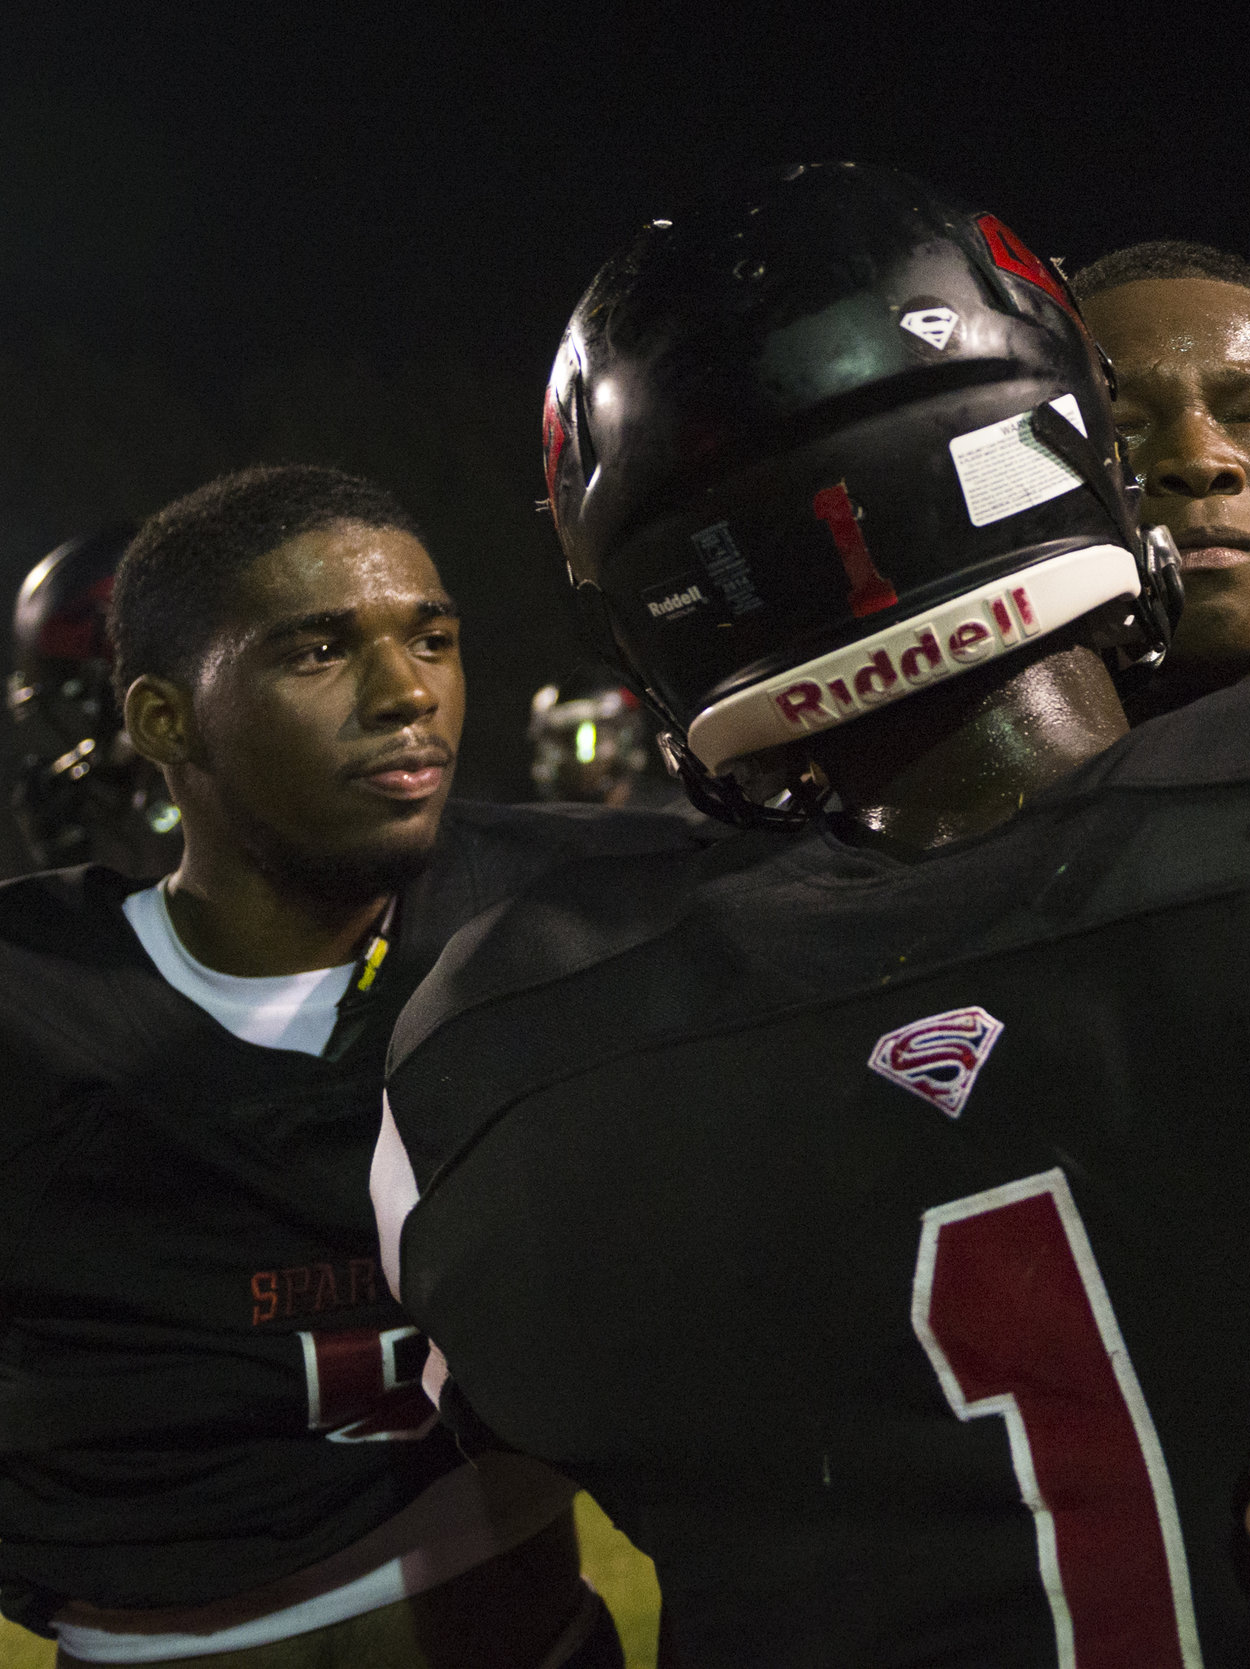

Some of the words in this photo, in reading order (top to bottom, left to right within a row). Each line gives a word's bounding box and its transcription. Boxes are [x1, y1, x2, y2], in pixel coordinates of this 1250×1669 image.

[647, 585, 702, 617] Riddell
[813, 484, 898, 618] 1
[769, 587, 1041, 730] Riddell
[911, 1166, 1204, 1669] 1
